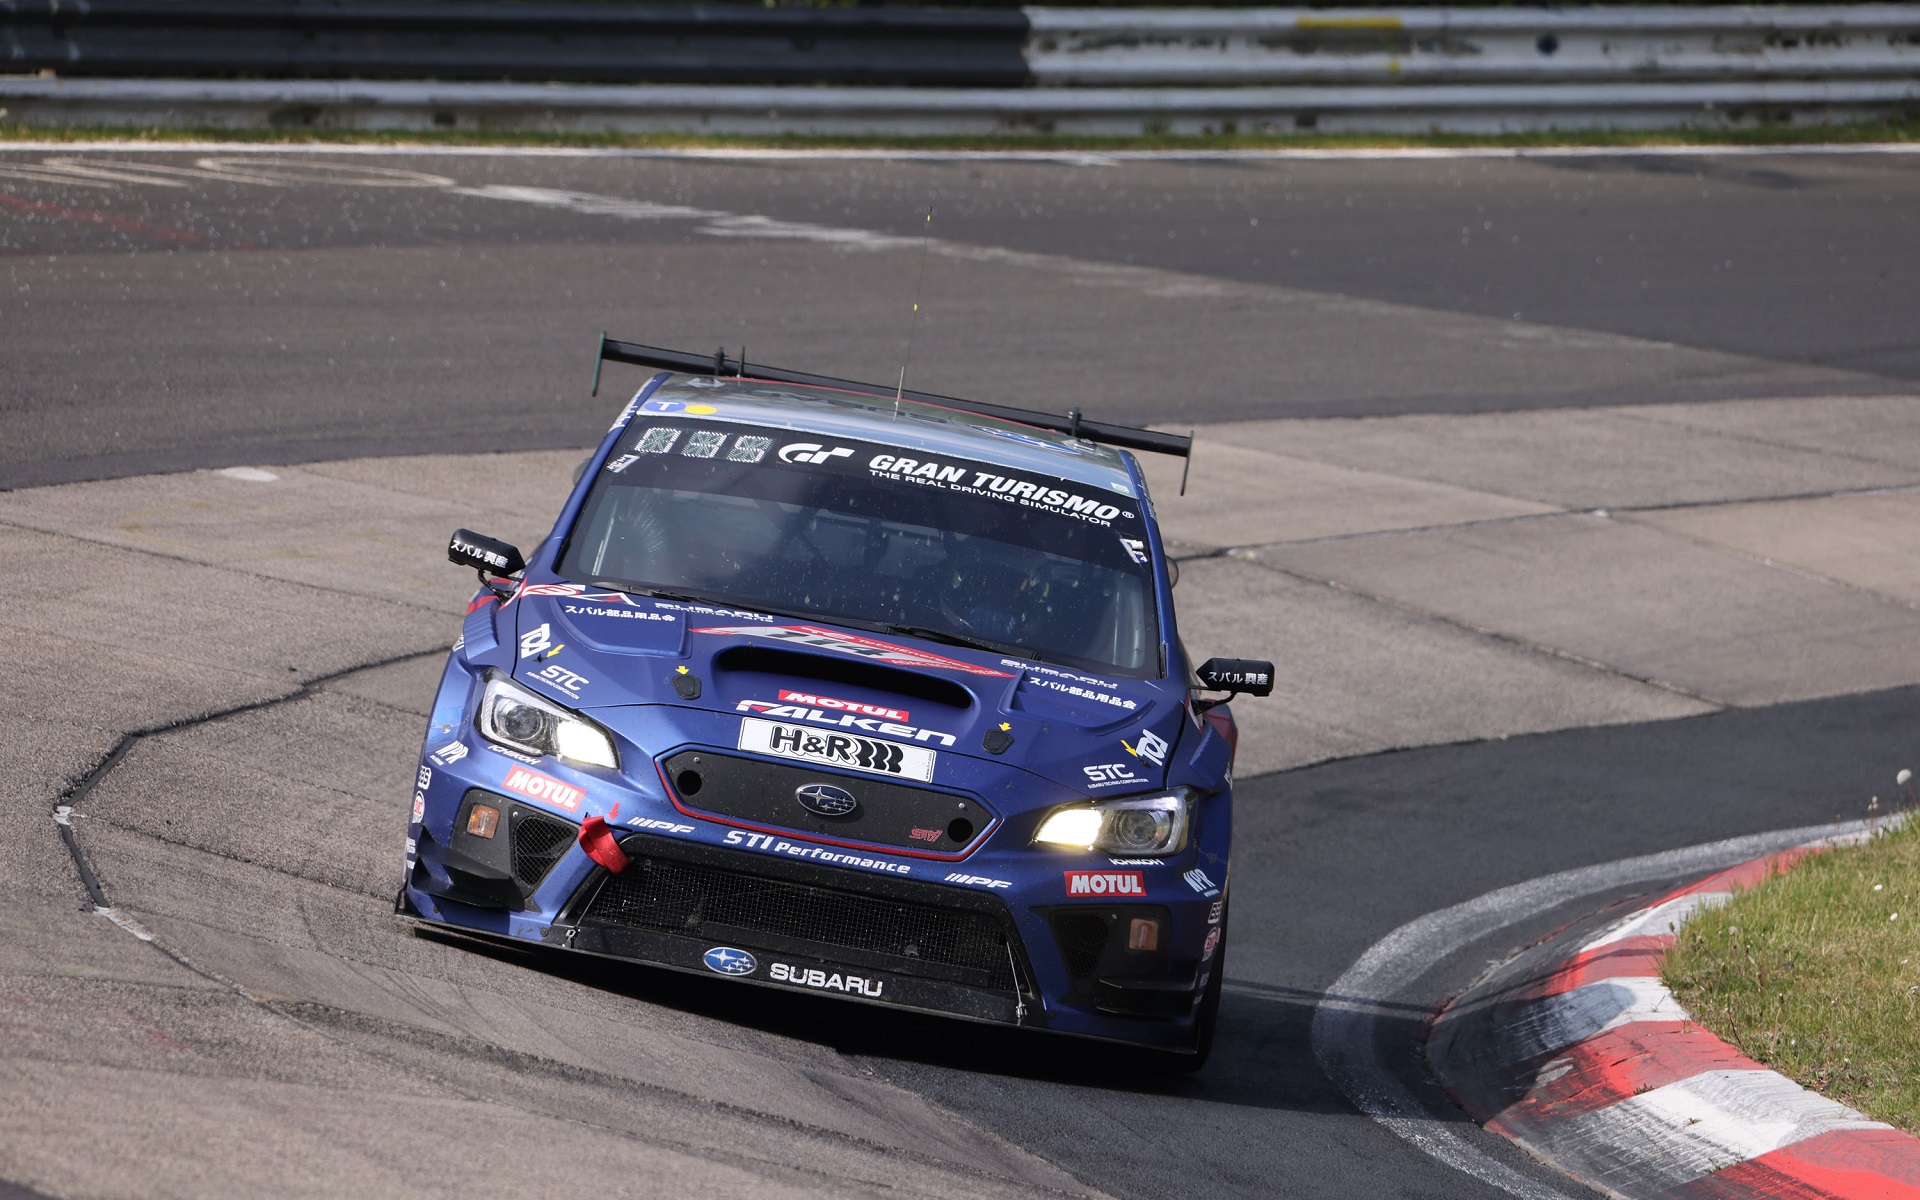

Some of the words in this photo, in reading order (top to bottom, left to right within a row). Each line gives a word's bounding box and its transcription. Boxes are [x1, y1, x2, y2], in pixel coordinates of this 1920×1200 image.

[869, 454, 966, 482] GRAN
[973, 471, 1120, 519] TURISMO
[869, 469, 900, 480] THE
[905, 476, 946, 489] REAL
[950, 484, 1015, 503] DRIVING
[1020, 498, 1111, 527] SIMULATOR
[540, 665, 590, 691] STC
[1029, 676, 1137, 710] スバル部品用品会
[734, 699, 957, 746] FALKEN
[784, 693, 904, 720] MOTUL
[769, 726, 855, 763] H&R
[507, 770, 580, 809] MOTUL
[1083, 763, 1134, 781] STC
[723, 830, 772, 850] STI
[1070, 875, 1142, 894] MOTUL
[770, 962, 883, 998] SUBARU
